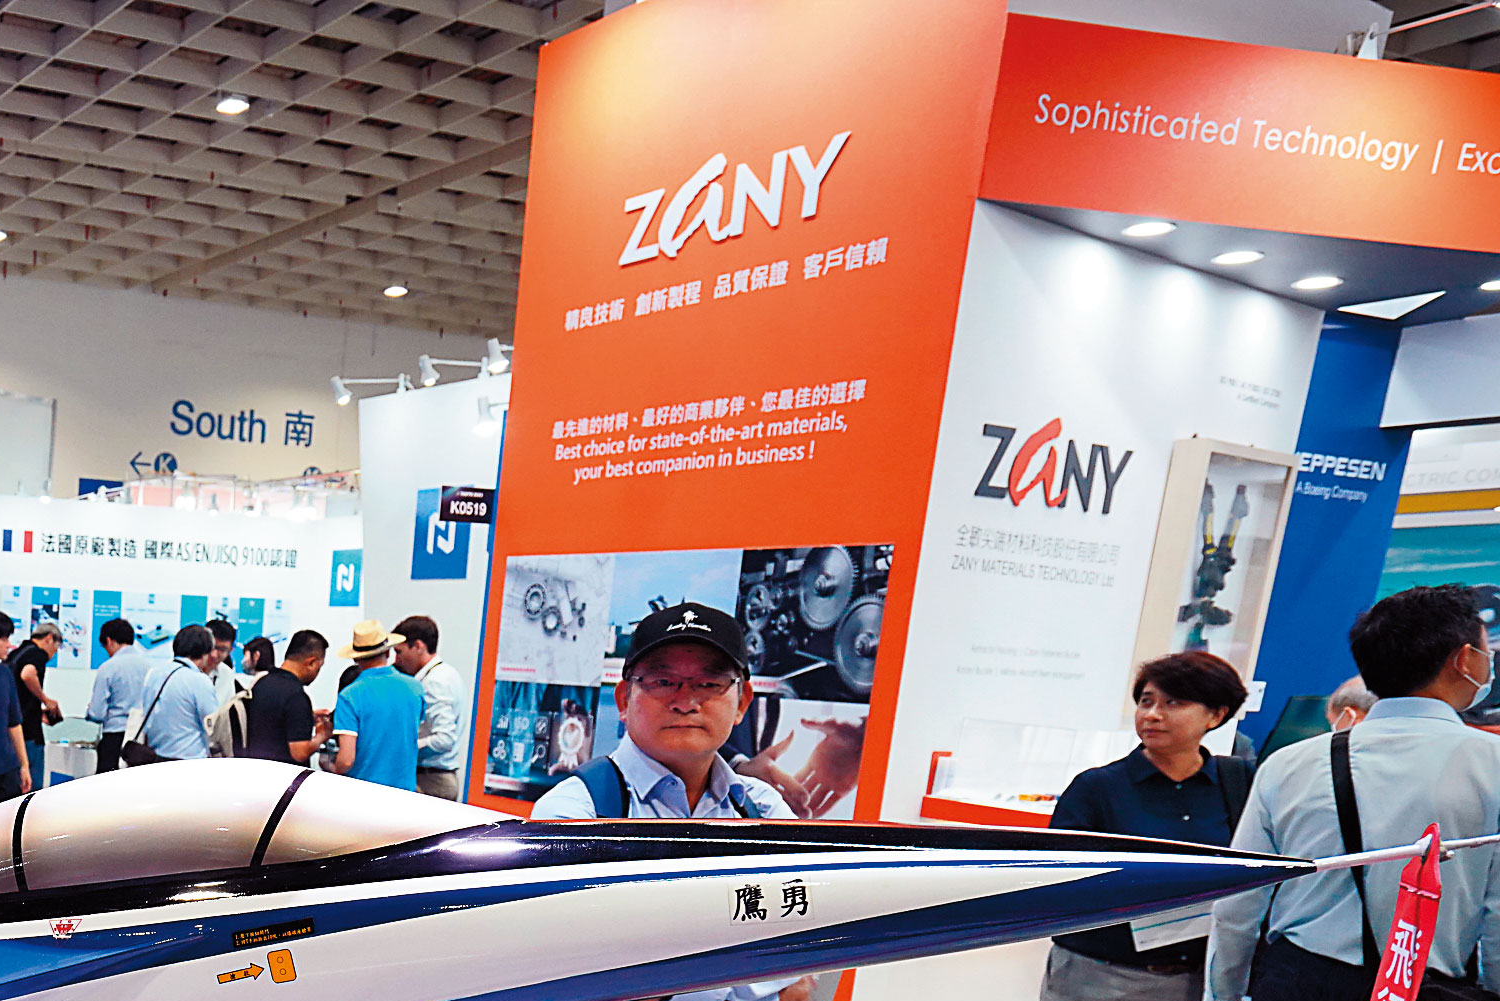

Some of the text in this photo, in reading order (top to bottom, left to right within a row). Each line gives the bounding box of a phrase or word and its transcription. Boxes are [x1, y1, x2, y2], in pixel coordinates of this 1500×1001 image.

[1033, 93, 1241, 147] Sophisticated
[1251, 119, 1419, 171] Technology
[564, 237, 890, 332] 精良技術 創新製程 品質保證 客戶信賴
[169, 399, 316, 448] South 南
[554, 410, 849, 461] Best choice for state-of-the-art materials,
[572, 463, 604, 485] your
[605, 457, 634, 478] best
[635, 450, 715, 476] companion
[717, 446, 733, 468] in
[735, 442, 805, 467] business
[1296, 451, 1387, 482] EPPESEN
[449, 500, 488, 517] K0519
[1331, 485, 1369, 503] Company
[40, 532, 138, 560] 法國原廠製造
